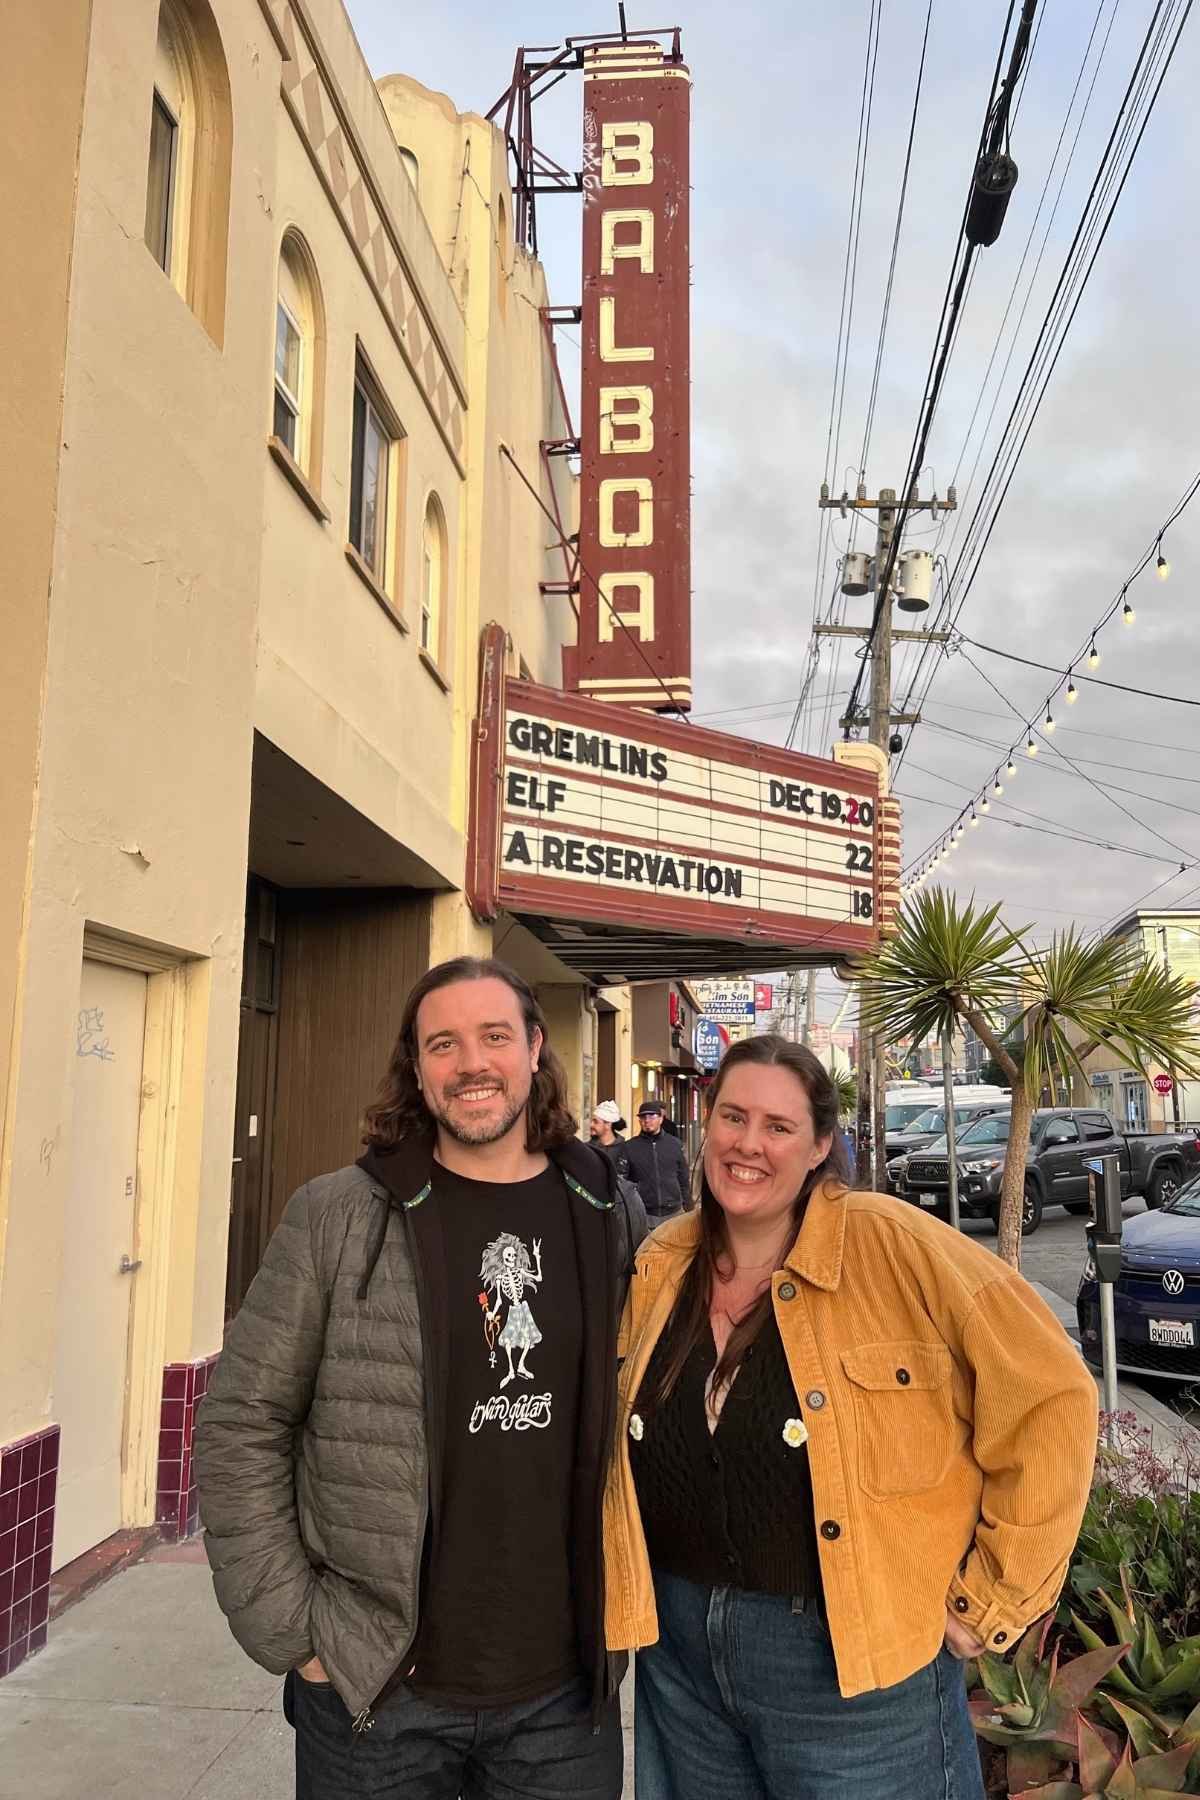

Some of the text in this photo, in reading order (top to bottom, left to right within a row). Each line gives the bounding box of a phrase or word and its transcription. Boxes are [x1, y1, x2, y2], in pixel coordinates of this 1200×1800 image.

[599, 120, 654, 643] BALBOA
[508, 718, 668, 782] GREMLINS
[506, 771, 566, 812] ELF
[769, 778, 814, 816] DEC
[506, 830, 742, 898] A RESERVATION
[845, 843, 873, 873] 22
[853, 889, 872, 918] 18
[1155, 1080, 1172, 1088] STOP
